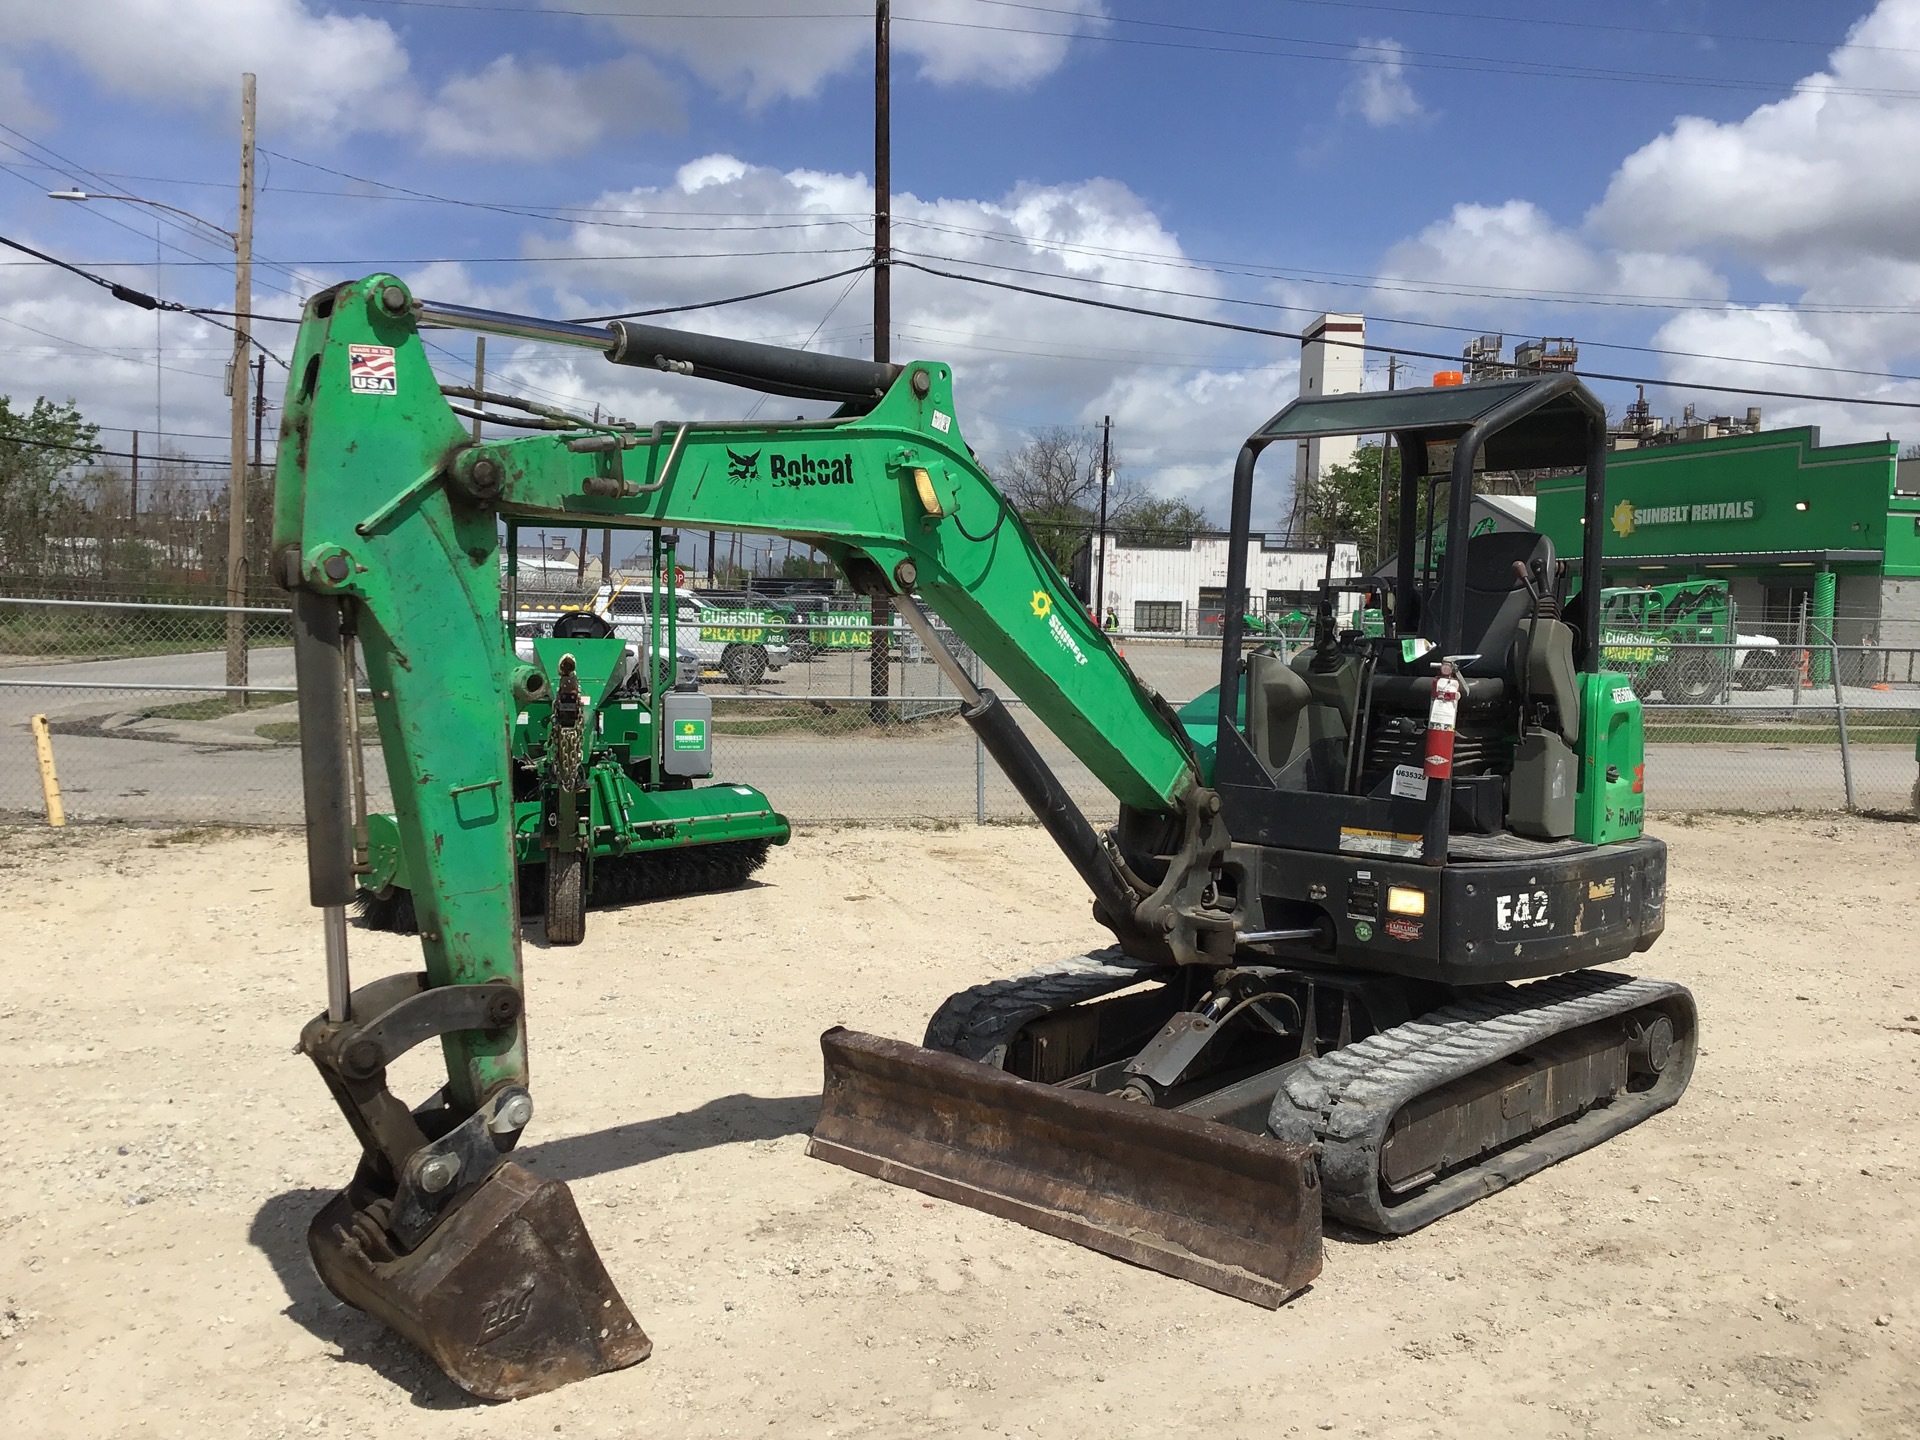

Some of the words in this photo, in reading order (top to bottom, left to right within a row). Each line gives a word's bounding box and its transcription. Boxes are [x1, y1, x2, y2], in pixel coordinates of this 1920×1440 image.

[354, 377, 393, 389] USA
[770, 453, 854, 489] Bobcat
[1634, 506, 1690, 525] SUNBELT
[1691, 501, 1754, 522] RENTALS
[663, 574, 684, 583] SP
[703, 610, 765, 625] CURBSIDE
[812, 615, 868, 627] SERVICIO
[702, 627, 763, 642] PICK-UP
[767, 635, 785, 643] AREA
[812, 632, 828, 644] EN
[831, 632, 848, 645] LA
[1606, 632, 1655, 645] CURBSIDE
[1497, 890, 1550, 932] E42
